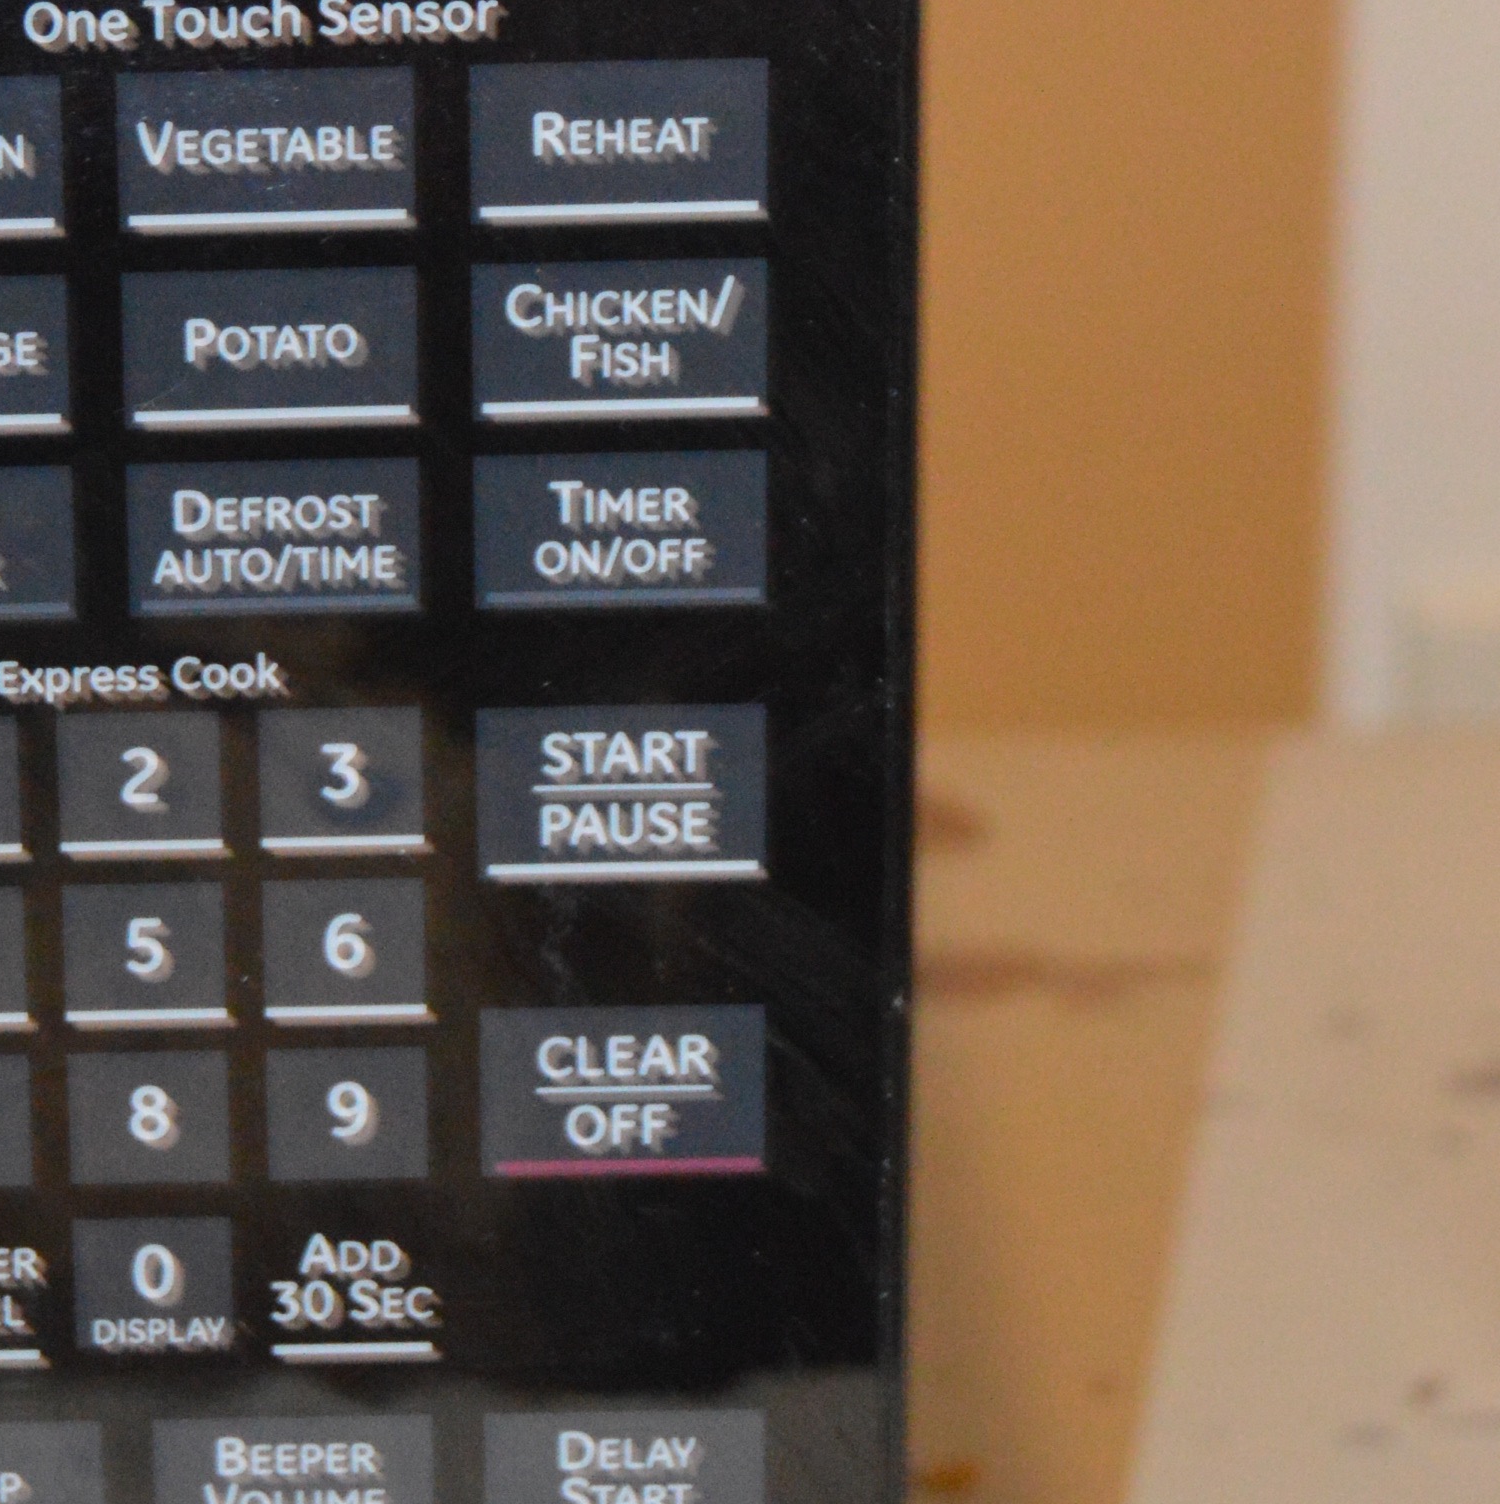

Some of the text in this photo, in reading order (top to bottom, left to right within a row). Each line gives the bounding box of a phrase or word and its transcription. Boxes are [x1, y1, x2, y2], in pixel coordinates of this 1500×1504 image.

[23, 1, 130, 46] One
[136, 121, 393, 167] VEGETABLE
[532, 111, 709, 157] REHEAT
[505, 275, 735, 330] CHICKEN/
[184, 318, 359, 363] POTATO
[570, 334, 671, 379] FISH
[172, 490, 378, 535] DEFROST
[548, 480, 691, 524] TIMER
[153, 544, 396, 586] AUTO/TIME
[534, 536, 706, 578] ON/OFF
[171, 652, 281, 693] Cook
[120, 747, 160, 807] 2
[321, 743, 361, 802] 3
[542, 731, 707, 778] START
[540, 802, 709, 847] PAUSE
[126, 918, 165, 976] 5
[324, 913, 366, 972] 6
[537, 1034, 711, 1080] CLEAR
[129, 1085, 171, 1143] 8
[327, 1081, 370, 1139] 9
[565, 1103, 669, 1148] OFF
[132, 1244, 176, 1301] 0
[299, 1233, 402, 1275] ADD
[271, 1278, 432, 1324] 30 SEC
[91, 1317, 225, 1346] DISPLAY
[215, 1437, 376, 1479] BEEPER
[557, 1431, 695, 1474] DELAY
